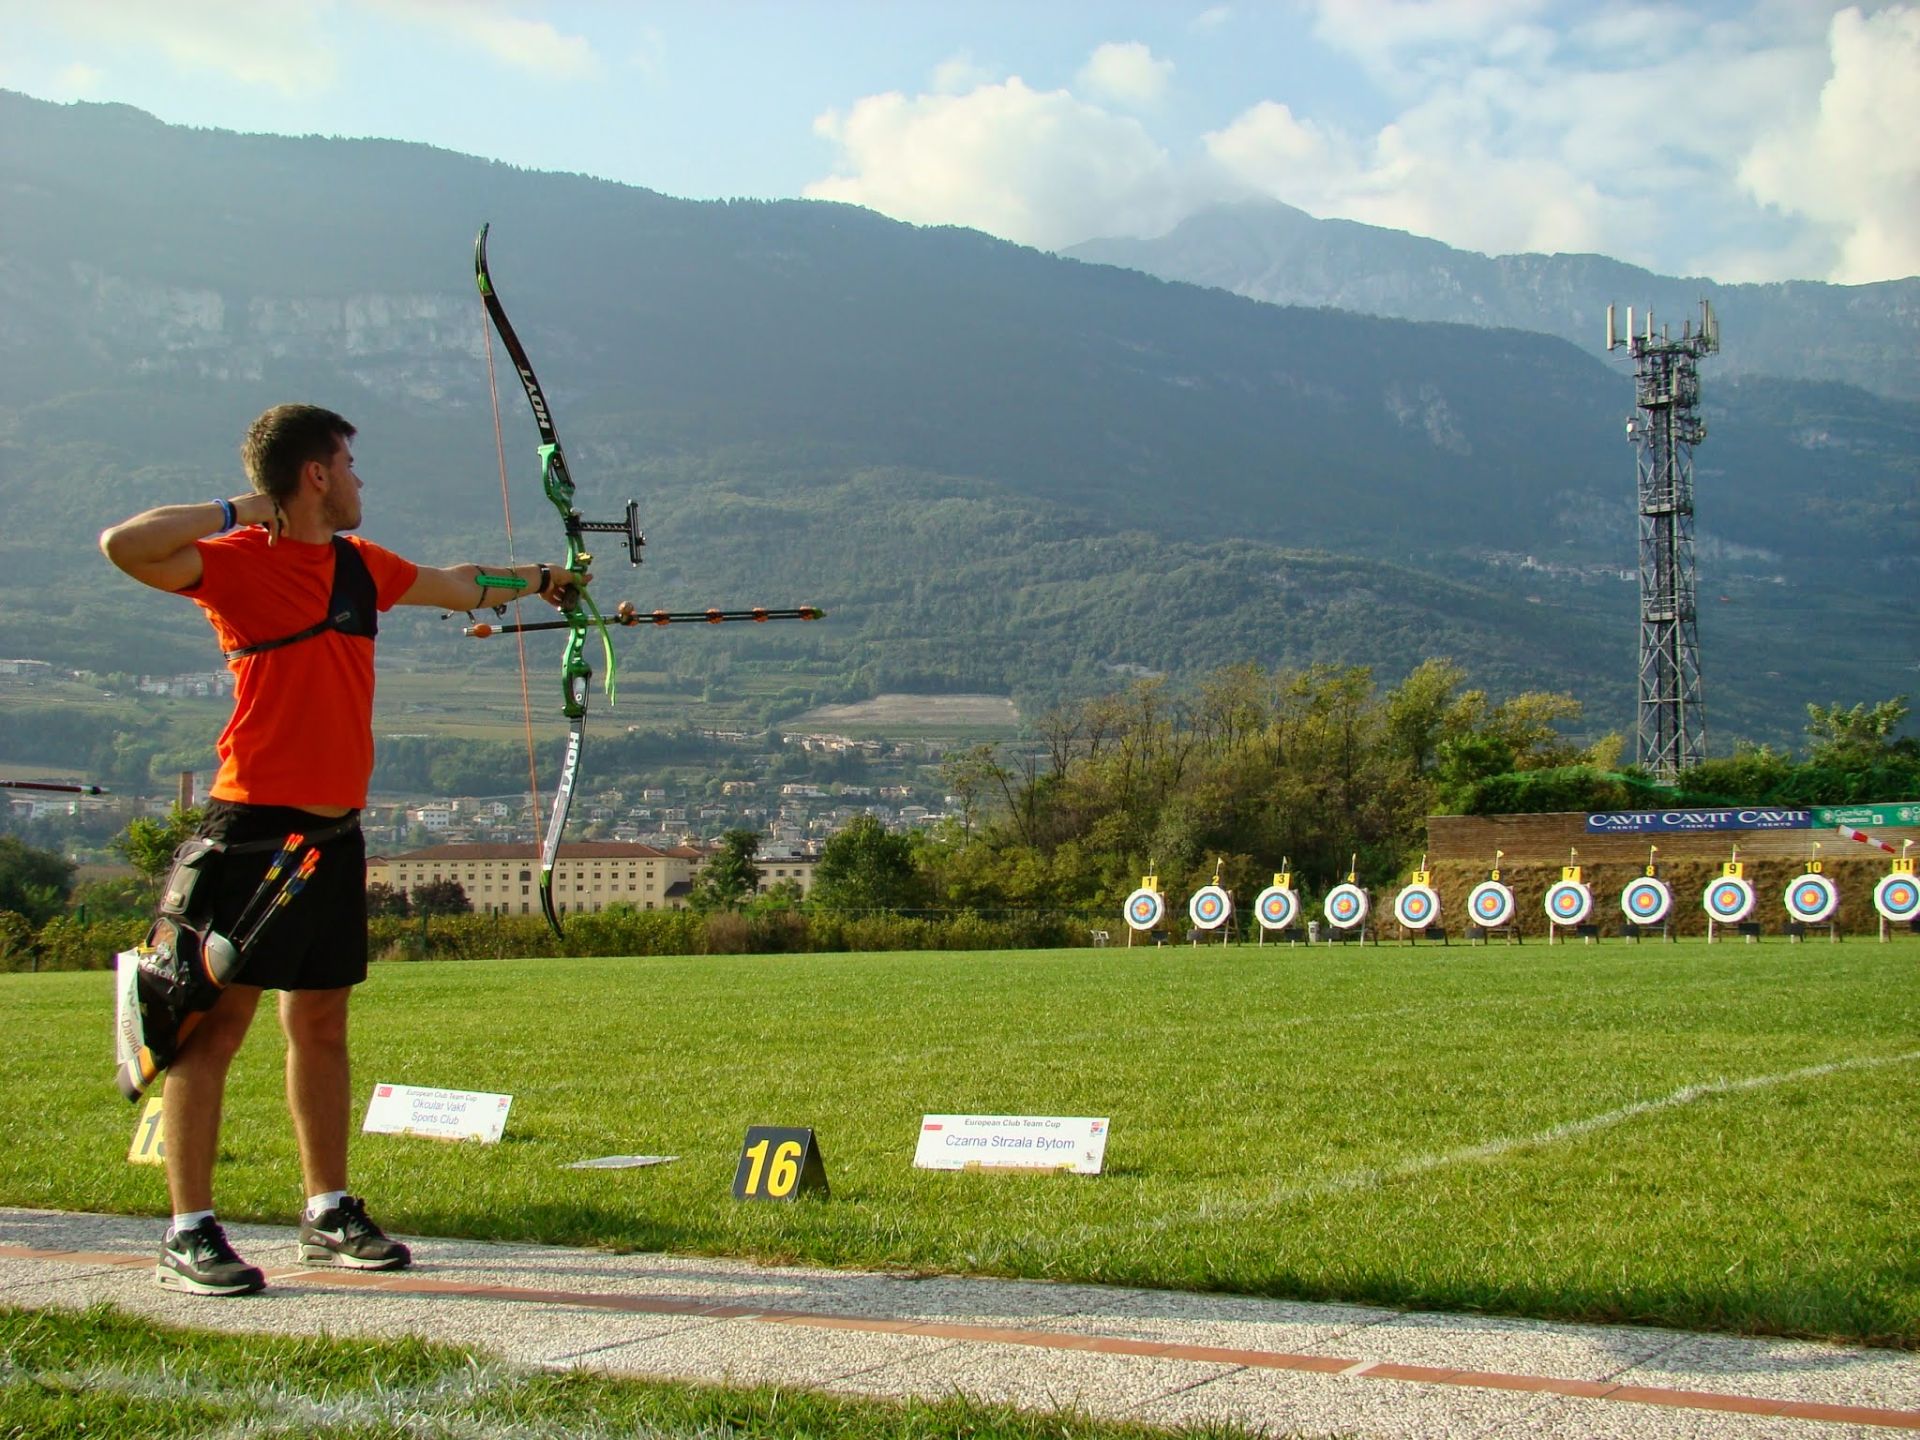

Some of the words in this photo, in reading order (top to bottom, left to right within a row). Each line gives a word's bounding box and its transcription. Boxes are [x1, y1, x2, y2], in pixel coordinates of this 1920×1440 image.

[517, 364, 551, 430] HOYT
[561, 731, 580, 798] HOYT
[1588, 813, 1657, 827] CAVIT
[1662, 811, 1733, 827] CAVIT
[1738, 809, 1811, 826] CAVIT
[406, 1088, 434, 1098] European
[434, 1091, 448, 1099] Club
[449, 1092, 465, 1100] Team
[465, 1094, 478, 1102] Cup
[411, 1112, 438, 1123] Sports
[439, 1115, 460, 1125] Club
[964, 1118, 1001, 1127] European
[1002, 1119, 1020, 1127] Club
[1023, 1119, 1043, 1128] Team
[1044, 1120, 1061, 1129] Cup
[140, 1109, 166, 1158] 1
[945, 1134, 987, 1147] Czarna
[990, 1135, 1032, 1149] Strzala
[1036, 1137, 1075, 1151] Bytom
[744, 1139, 802, 1197] 16
